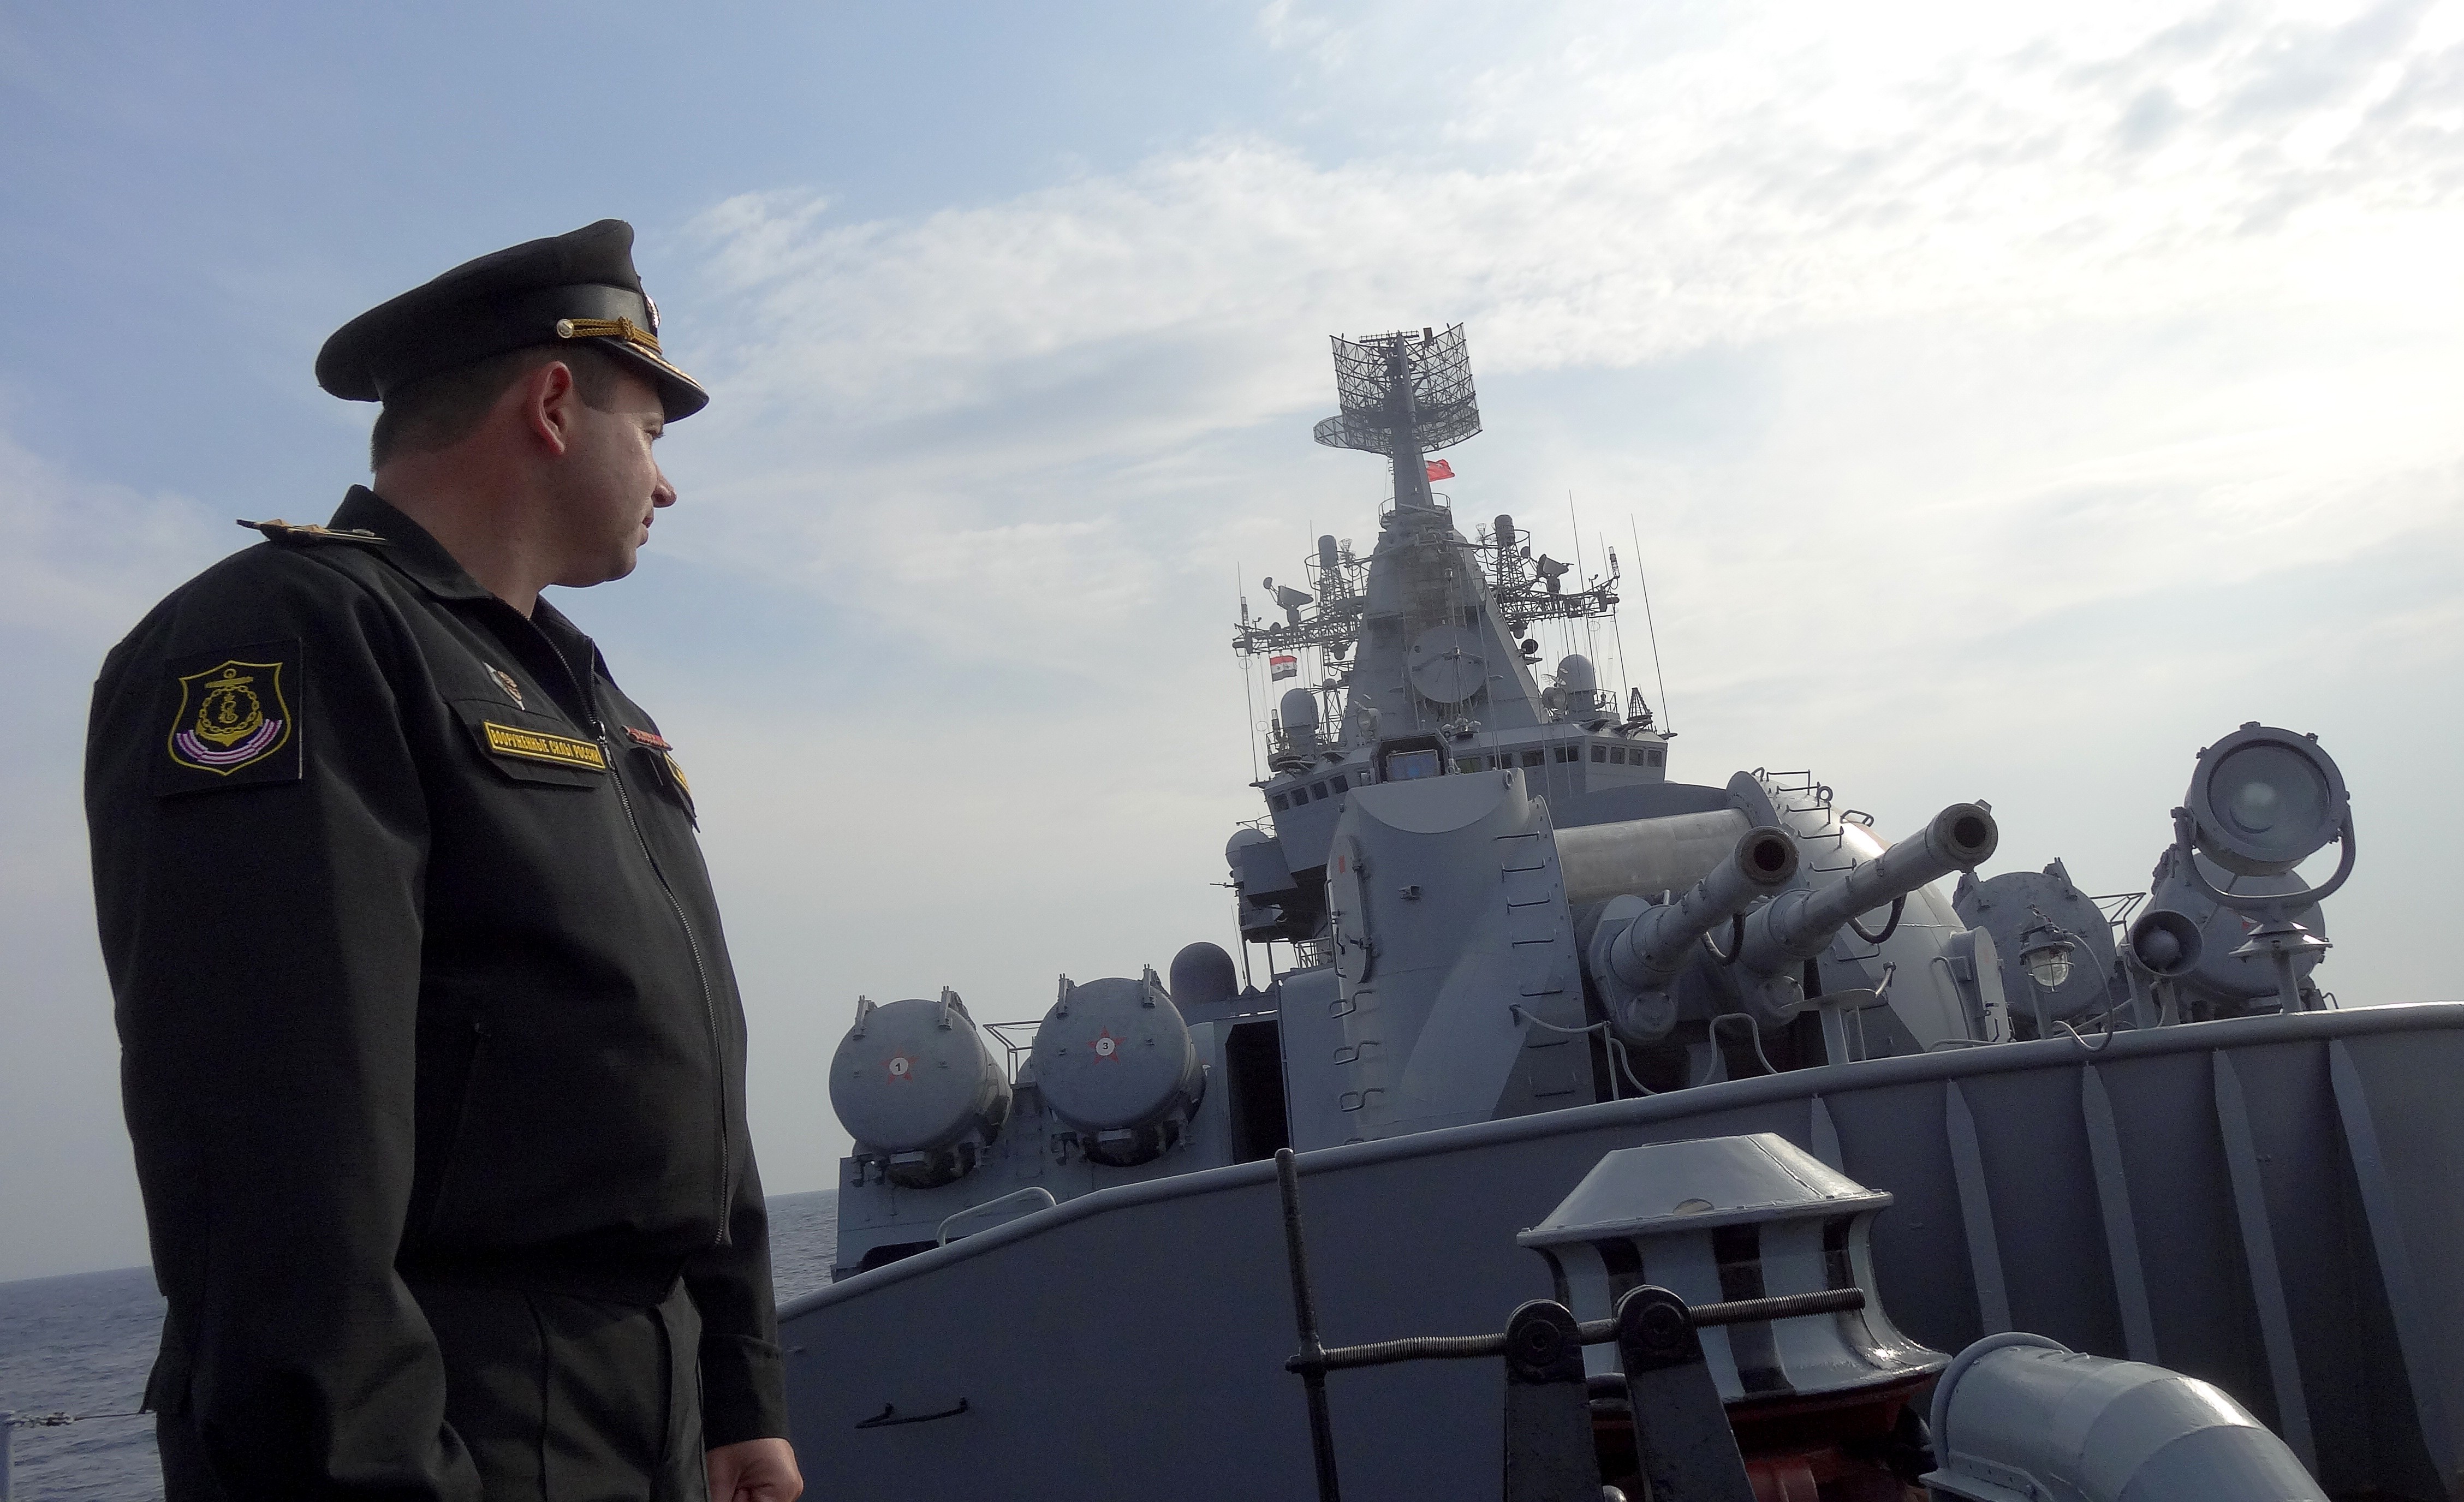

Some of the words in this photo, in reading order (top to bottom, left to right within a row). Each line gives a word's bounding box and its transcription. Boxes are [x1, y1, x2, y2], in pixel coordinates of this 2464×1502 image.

[491, 729, 549, 753] ВООРУЖЕННЫЕ
[549, 740, 573, 757] СИЛЫ
[895, 1062, 901, 1071] 1
